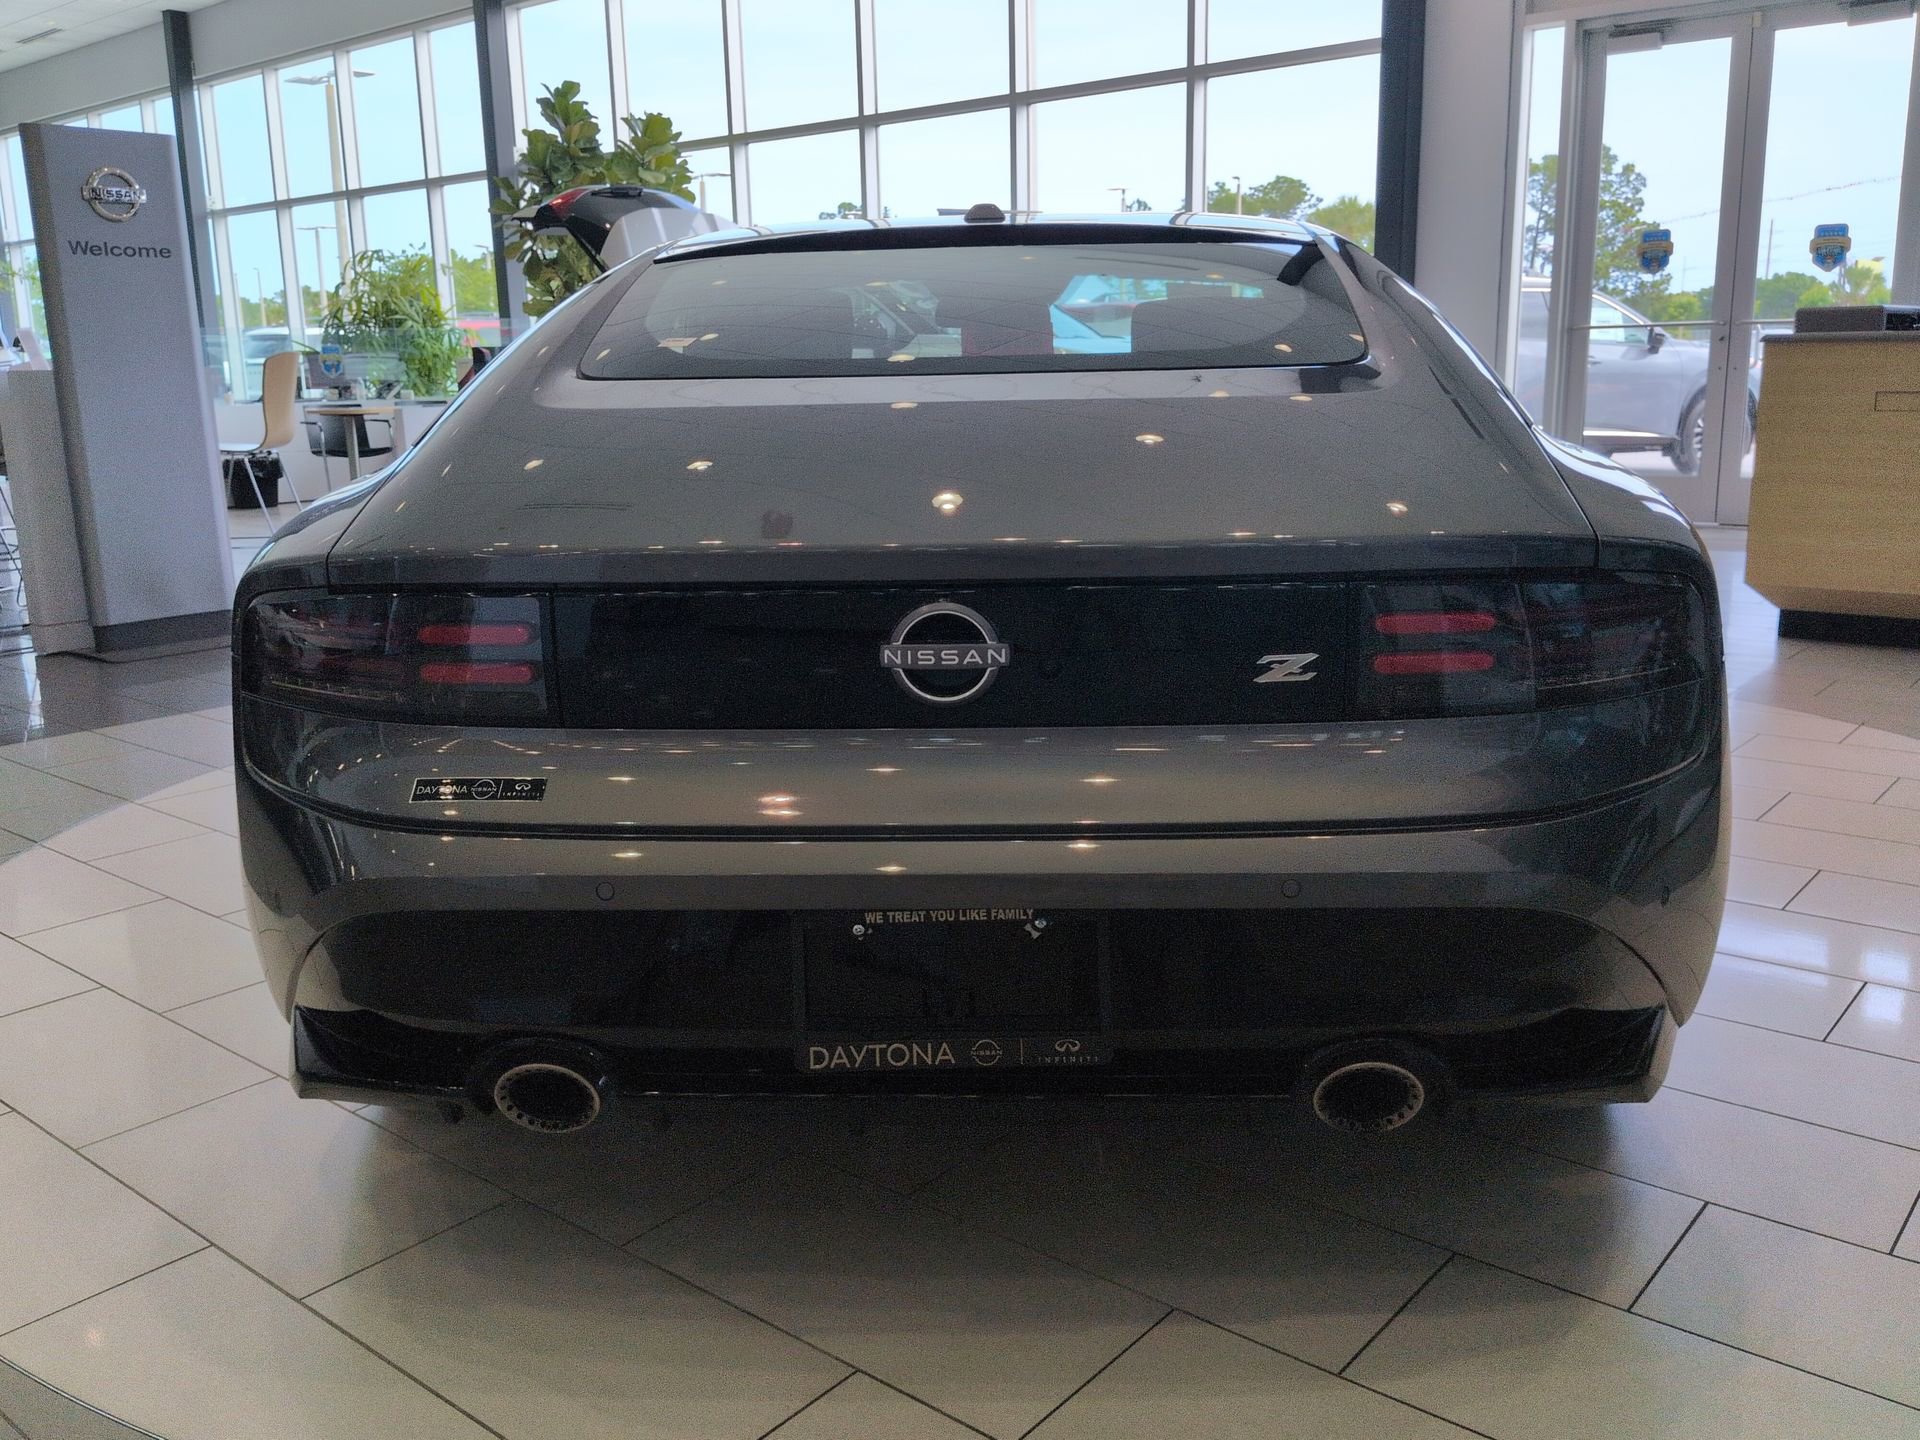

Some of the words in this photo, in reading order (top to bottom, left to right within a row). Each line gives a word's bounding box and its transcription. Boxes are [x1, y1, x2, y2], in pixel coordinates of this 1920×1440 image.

[90, 188, 142, 199] NISSAN
[67, 239, 172, 259] Welcome
[883, 647, 1007, 665] NISSAN
[1252, 652, 1320, 683] Z
[416, 785, 468, 795] DAYTONA
[864, 911, 884, 924] WE
[886, 911, 927, 923] TREAT
[929, 910, 955, 922] YOU
[959, 909, 988, 921] LIKE
[990, 908, 1034, 920] FAMILY
[809, 1042, 956, 1069] DAYTONA
